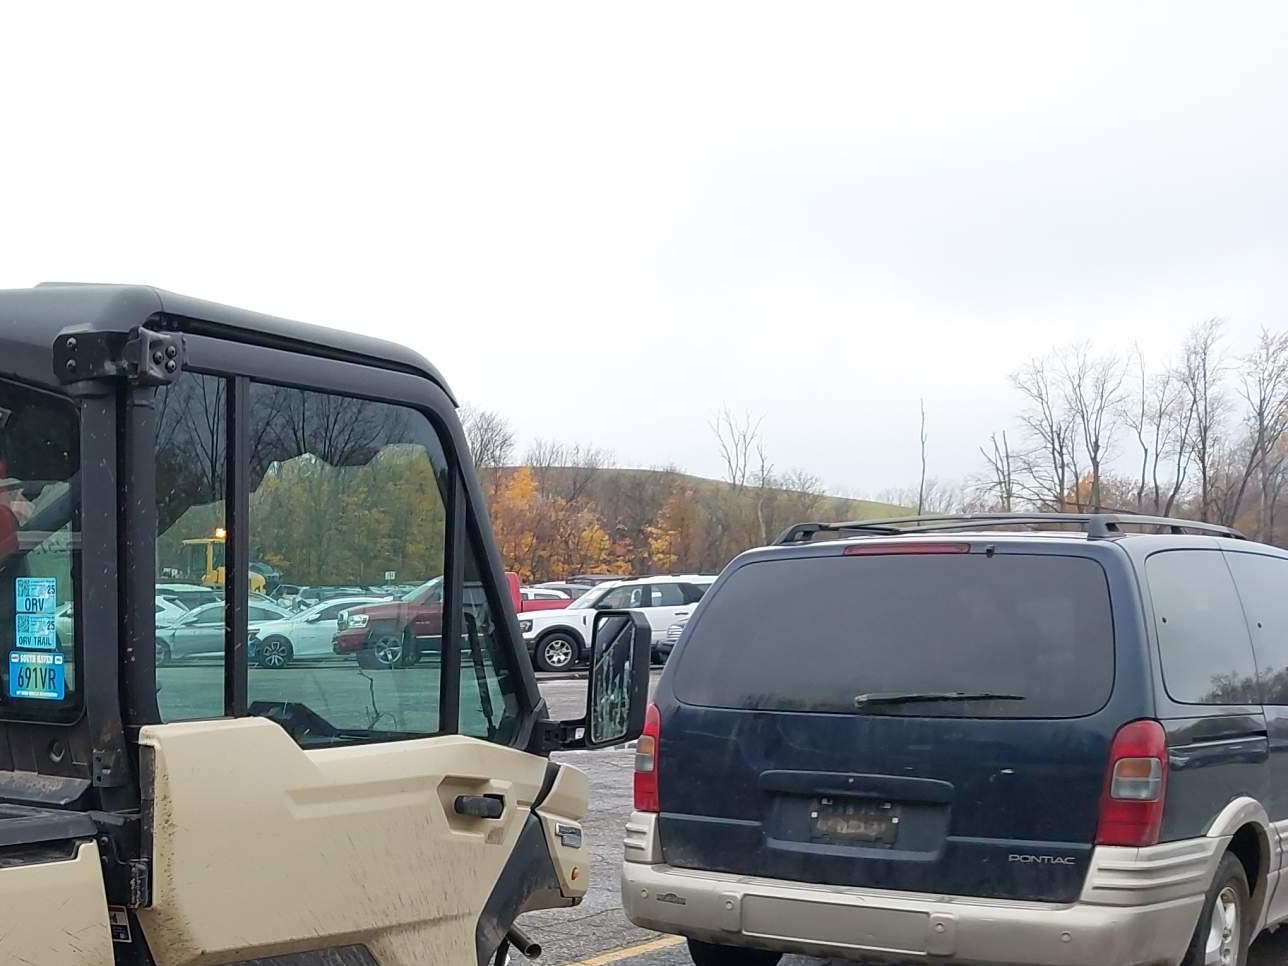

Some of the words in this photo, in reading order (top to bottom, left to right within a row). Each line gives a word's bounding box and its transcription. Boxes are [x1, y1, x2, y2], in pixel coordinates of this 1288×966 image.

[47, 584, 56, 595] 25
[24, 598, 45, 612] ORV
[47, 620, 56, 631] 25
[18, 635, 32, 646] ORV
[33, 636, 53, 647] TRAIL
[17, 666, 57, 690] 691VR
[1008, 854, 1077, 865] PONTIAC
